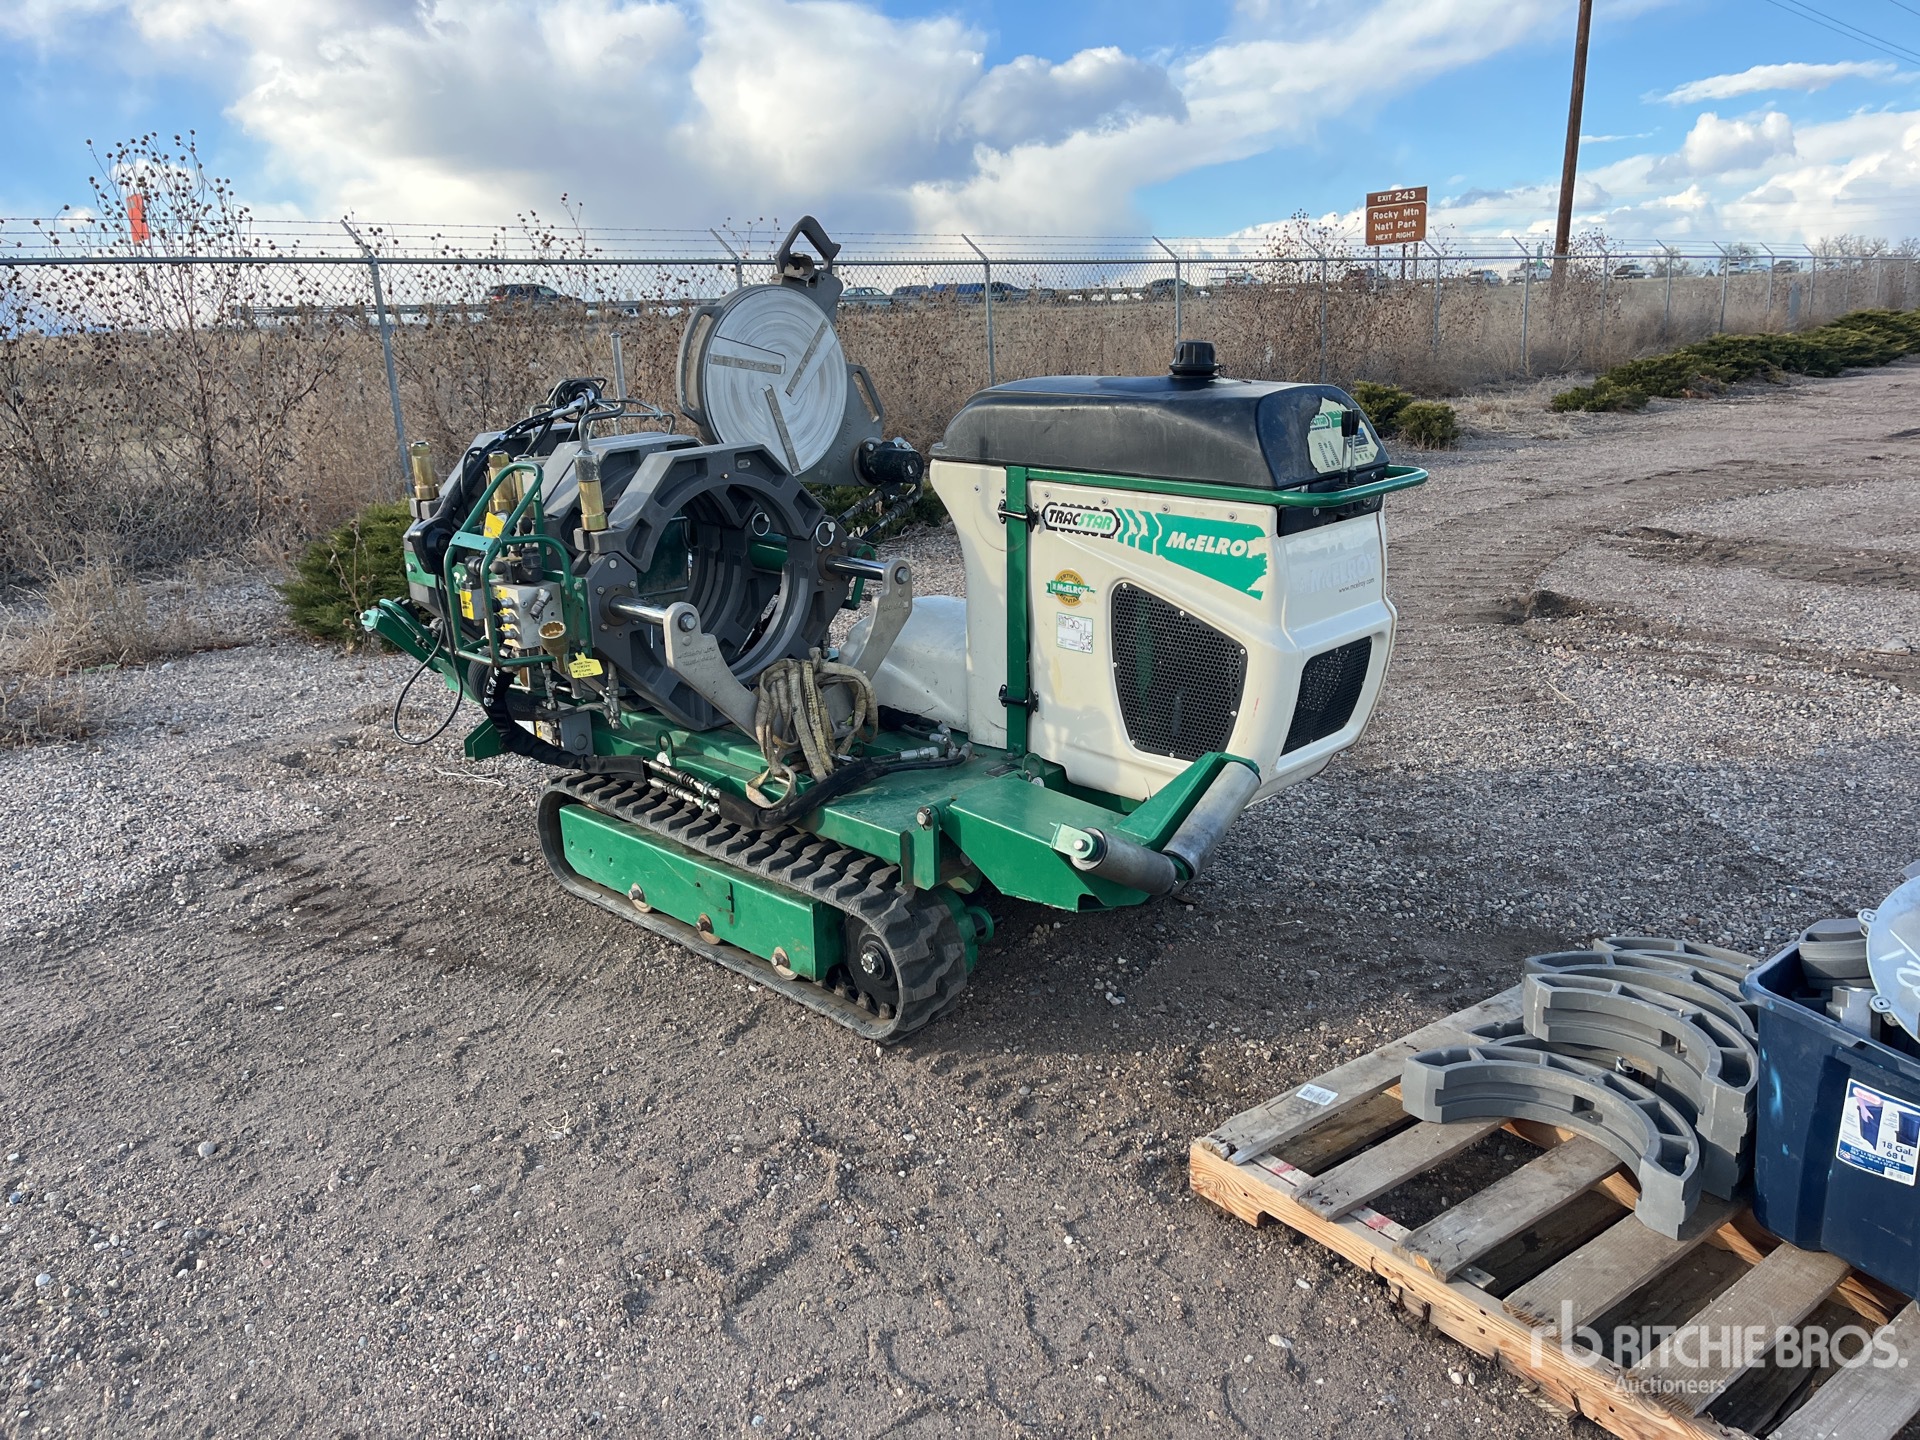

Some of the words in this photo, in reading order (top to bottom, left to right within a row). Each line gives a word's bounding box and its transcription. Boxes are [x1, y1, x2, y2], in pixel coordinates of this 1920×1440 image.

[1395, 190, 1416, 201] 243
[1373, 210, 1399, 220] Rocky
[1404, 208, 1419, 216] Mtn
[1374, 221, 1393, 231] Nat'l
[1398, 220, 1416, 228] Park
[1375, 233, 1393, 241] NEXT
[1395, 231, 1416, 239] RIGHT
[1048, 508, 1113, 531] TRACSTAR
[1882, 1140, 1893, 1149] 18
[1895, 1145, 1914, 1157] Gal.
[1886, 1150, 1898, 1160] 68
[1900, 1153, 1906, 1162] L
